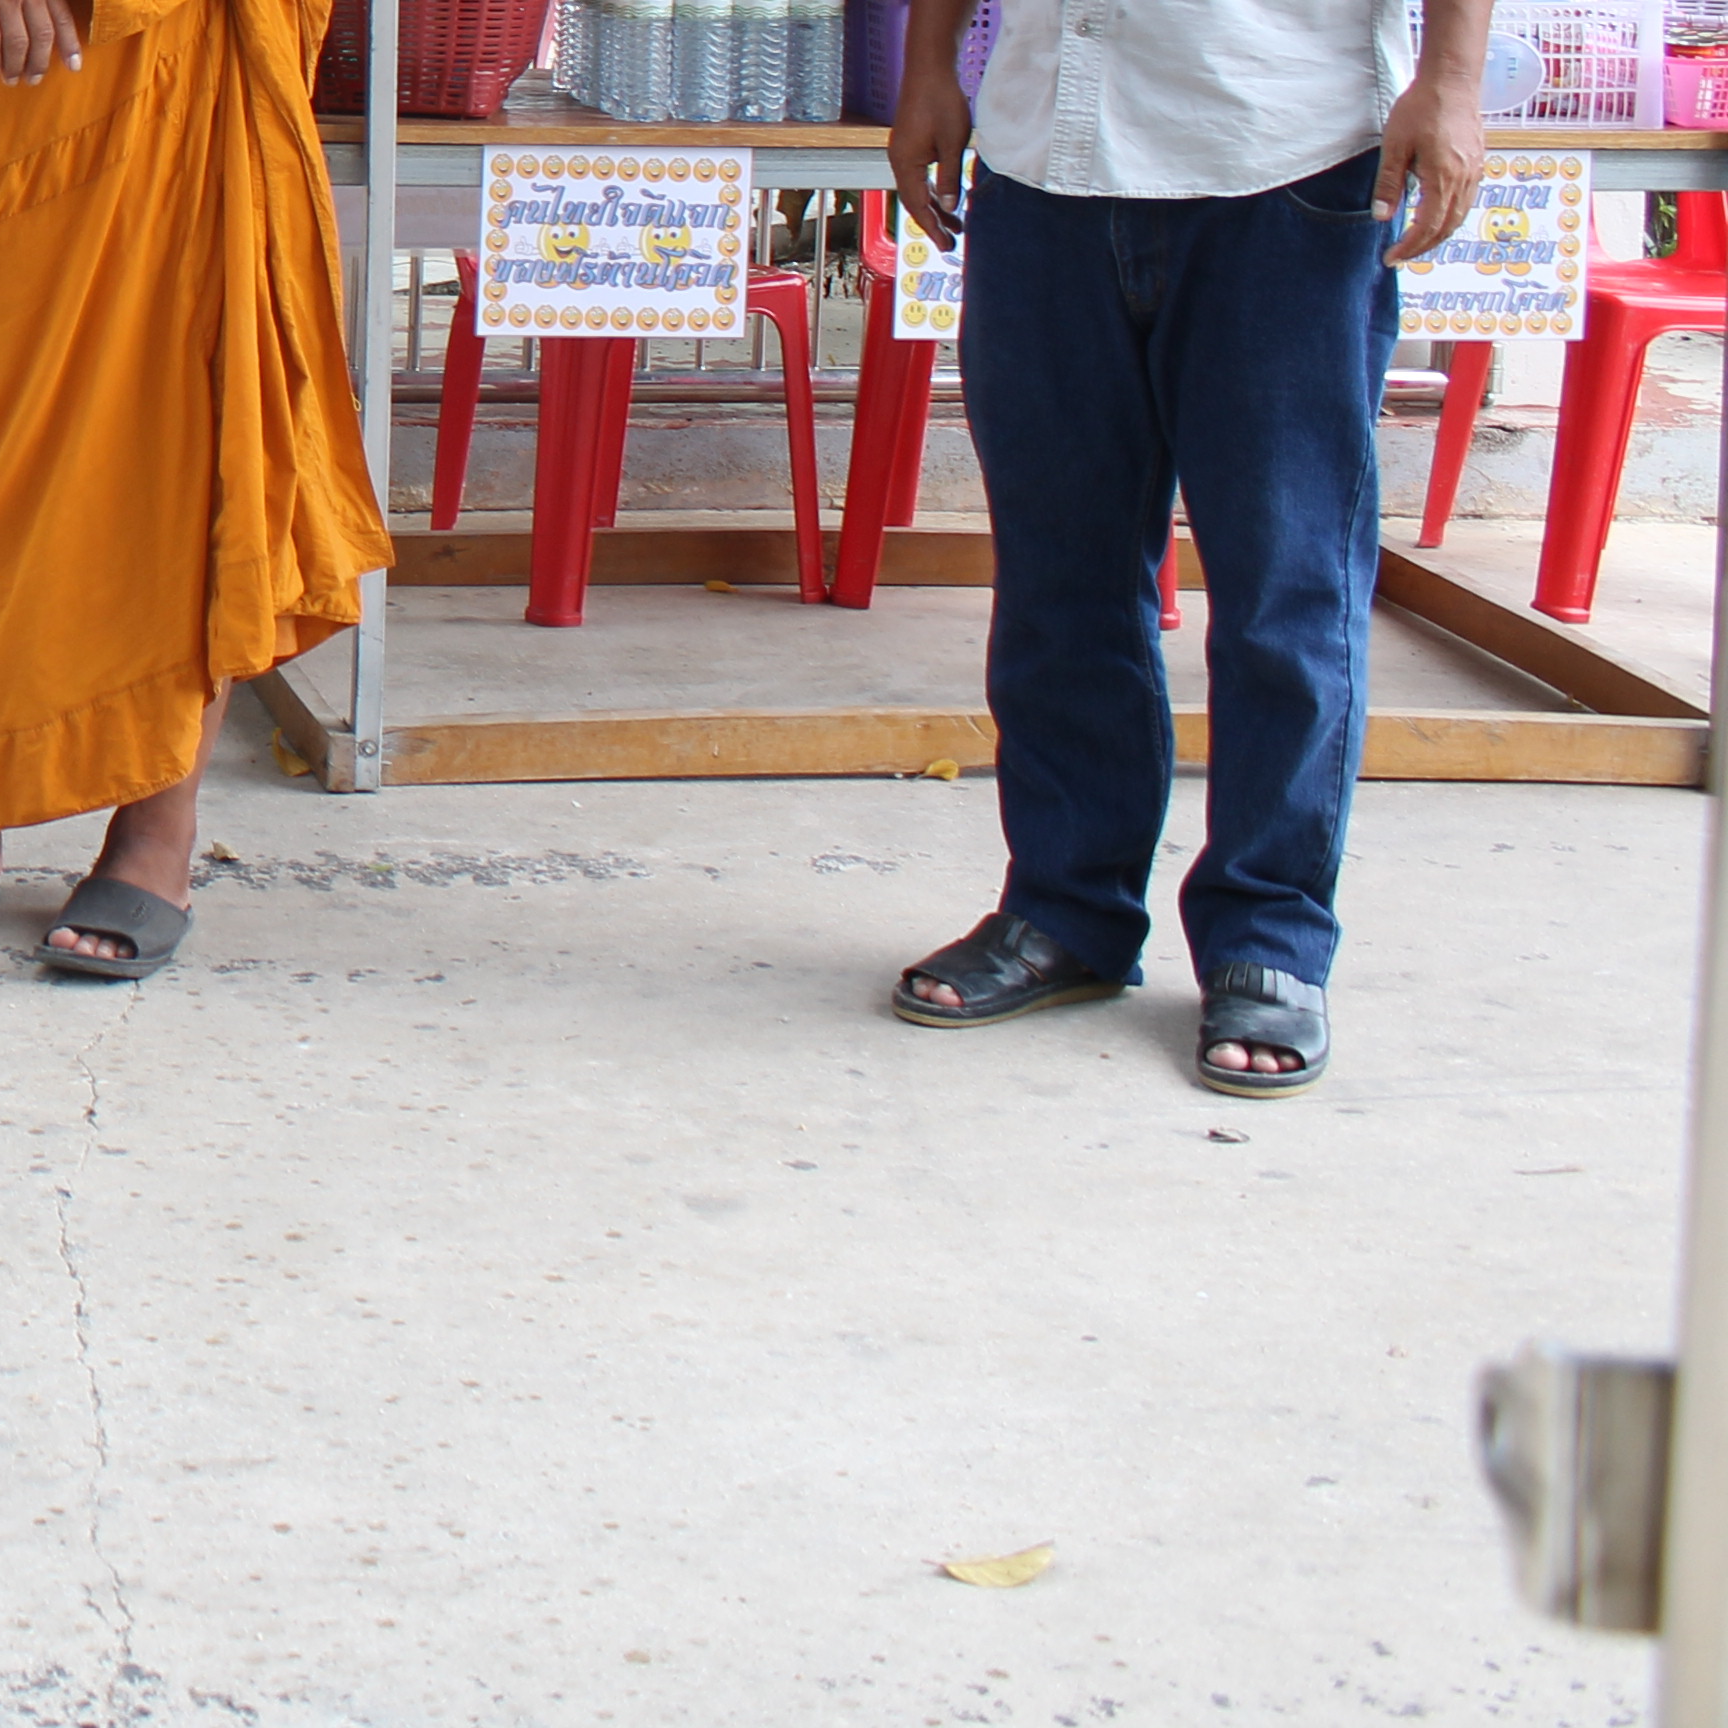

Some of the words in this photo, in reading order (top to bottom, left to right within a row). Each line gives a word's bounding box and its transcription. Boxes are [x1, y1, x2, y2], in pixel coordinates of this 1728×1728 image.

[499, 182, 734, 231] คนไทยใจดีแจก
[494, 245, 736, 292] ของฟรีต้านโควิด
